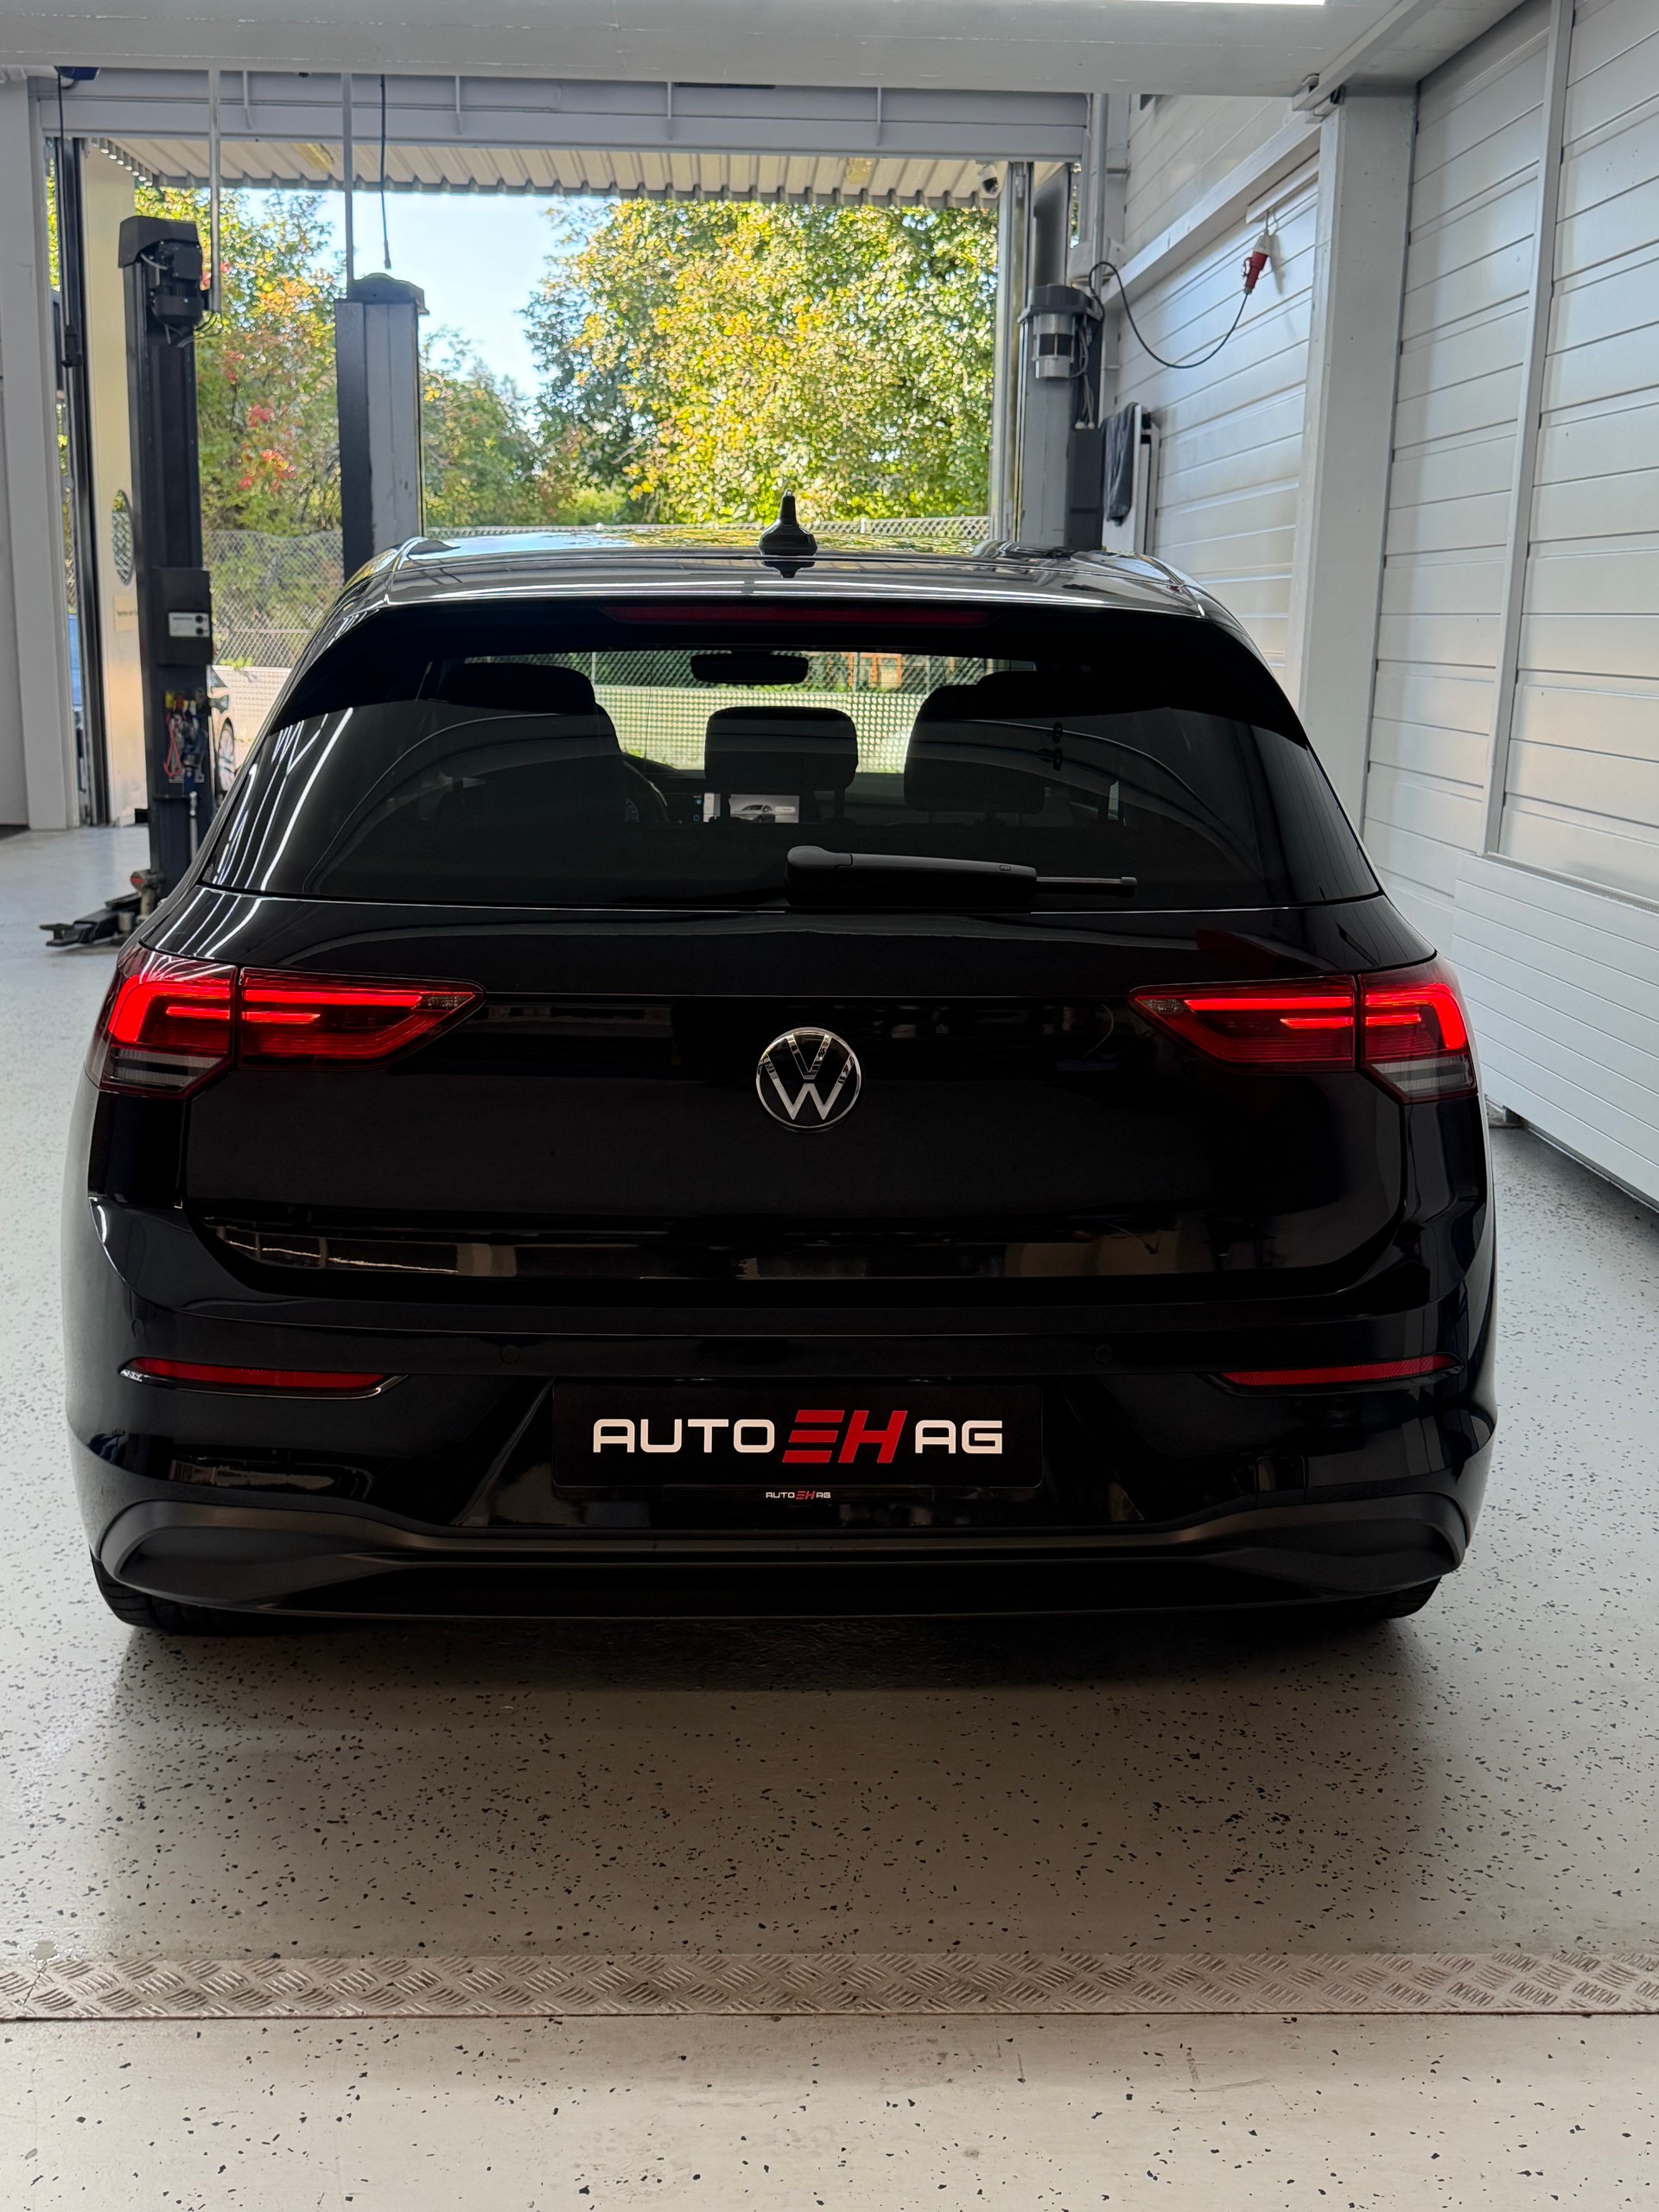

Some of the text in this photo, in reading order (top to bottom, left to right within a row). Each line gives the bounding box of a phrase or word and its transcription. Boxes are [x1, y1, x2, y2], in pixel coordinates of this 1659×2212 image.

[758, 1031, 858, 1122] VW
[593, 1409, 1003, 1464] AUTO EH AG
[795, 1491, 816, 1500] EH
